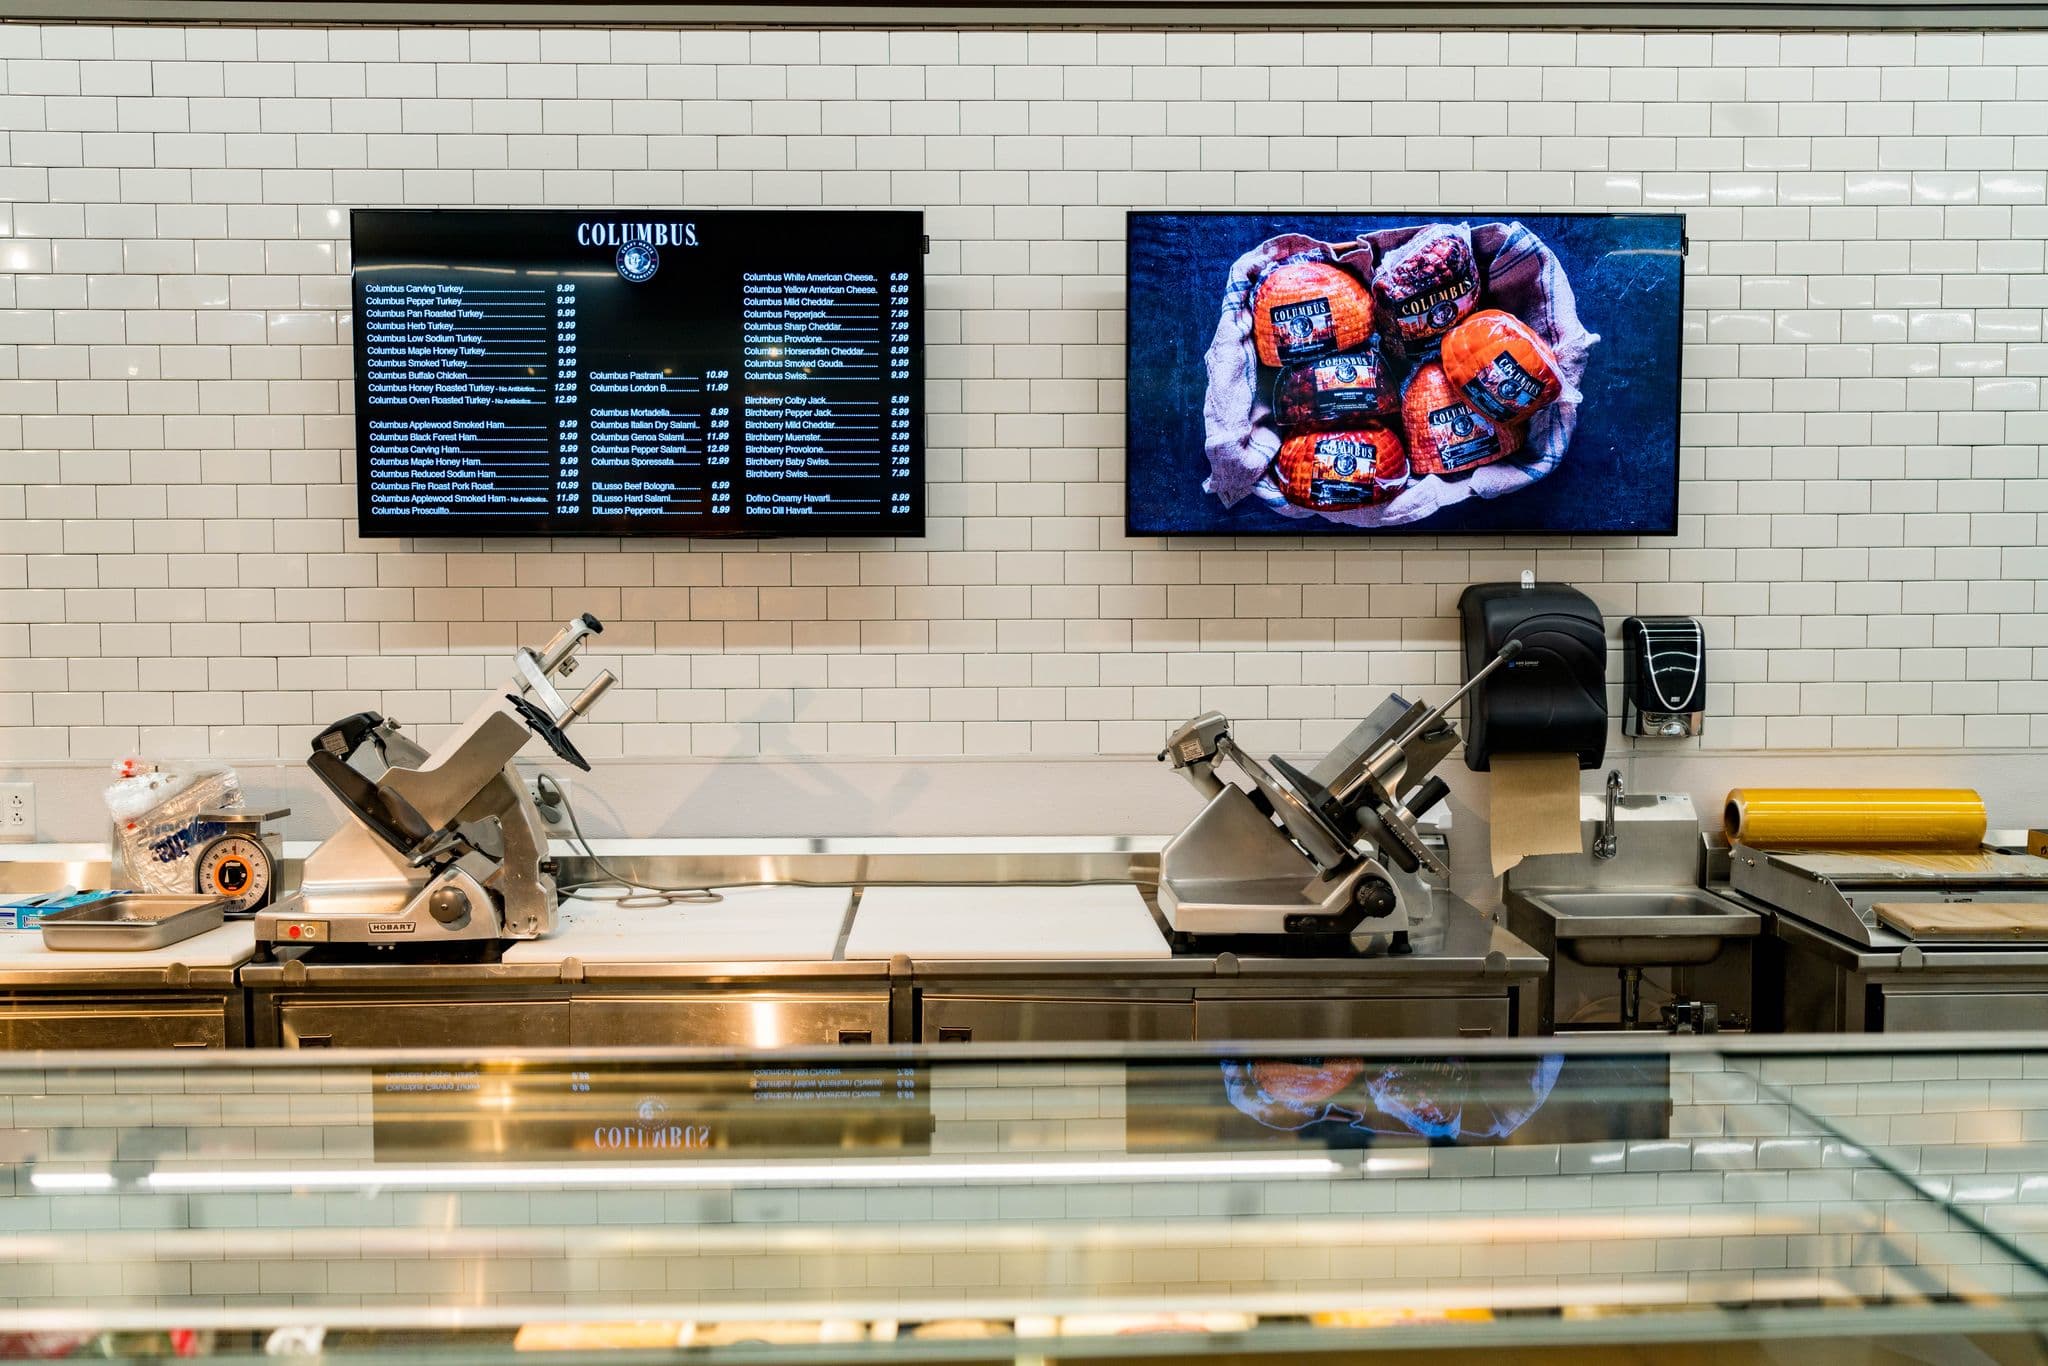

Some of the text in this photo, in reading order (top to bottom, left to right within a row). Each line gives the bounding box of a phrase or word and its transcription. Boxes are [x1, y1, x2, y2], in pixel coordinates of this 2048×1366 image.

[577, 222, 698, 247] COLUMBUS
[744, 273, 908, 281] Columbus White American Cheese 6.99
[366, 284, 575, 294] Columbus Carving Turkey 9.99
[744, 285, 908, 294] Columbus Yellow American Cheese 6.99
[366, 296, 575, 307] Columbus Pepper Turkey 9.99
[744, 297, 908, 306] Columbus Mild Cheddar 7.99
[744, 310, 908, 320] Columbus Pepperjack 7.99
[1273, 301, 1327, 322] COLUMBUS
[367, 321, 575, 332] Columbus Herb Turkey 9.99
[744, 322, 908, 333] Columbus Sharp Cheddar 7.99
[456, 335, 482, 344] Turkey
[558, 334, 576, 342] 9.99
[744, 334, 909, 343] Columbus Provolone 7.99
[891, 359, 909, 367] 9.99
[559, 371, 576, 379] 9.99
[706, 371, 728, 379] 10.99
[745, 371, 909, 380] Columbus Swiss 9.99
[590, 383, 728, 392] Columbus London B 11.99
[785, 396, 806, 406] Colby
[808, 396, 826, 404] Jack
[891, 396, 909, 404] 5.99
[711, 408, 729, 416] 8.99
[370, 420, 577, 430] Columbus Applewood Smoked Ham 9.99
[591, 421, 629, 429] Columbus
[655, 421, 668, 430] Dry
[670, 421, 696, 429] Salami
[711, 420, 729, 428] 9.99
[785, 421, 800, 429] Mild
[802, 421, 835, 429] Cheddar
[891, 420, 909, 428] 5.99
[370, 433, 408, 441] Columbus
[410, 433, 431, 441] Black
[433, 433, 456, 441] Forest
[459, 433, 477, 441] Ham
[891, 433, 909, 441] 5.99
[410, 446, 439, 455] Carving
[560, 445, 578, 453] 9.99
[631, 446, 658, 455] Pepper
[891, 445, 909, 453] 5.99
[786, 458, 805, 468] Baby
[807, 458, 829, 466] Swiss
[892, 457, 909, 465] 7.99
[371, 470, 409, 478] Columbus
[411, 470, 445, 478] Reduced
[447, 470, 475, 478] Sodium
[478, 470, 496, 478] Ham
[786, 470, 808, 478] Swiss
[892, 469, 909, 478] 7.99
[371, 482, 409, 490] Columbus
[412, 482, 426, 490] Fire
[428, 482, 450, 490] Roast
[452, 482, 469, 490] Pork
[472, 482, 493, 490] Roast
[625, 482, 642, 490] Beef
[644, 482, 675, 492] Bologna
[712, 481, 730, 489] 6.99
[625, 494, 642, 502] Hard
[645, 494, 671, 502] Salami
[712, 493, 730, 501] 8.99
[772, 495, 802, 504] Creamy
[892, 494, 910, 502] 8.99
[625, 506, 663, 516] Pepperoni
[712, 506, 730, 514] 8.99
[746, 506, 910, 515] Dofino Dill Havarti 8.99
[372, 923, 412, 931] HOBART
